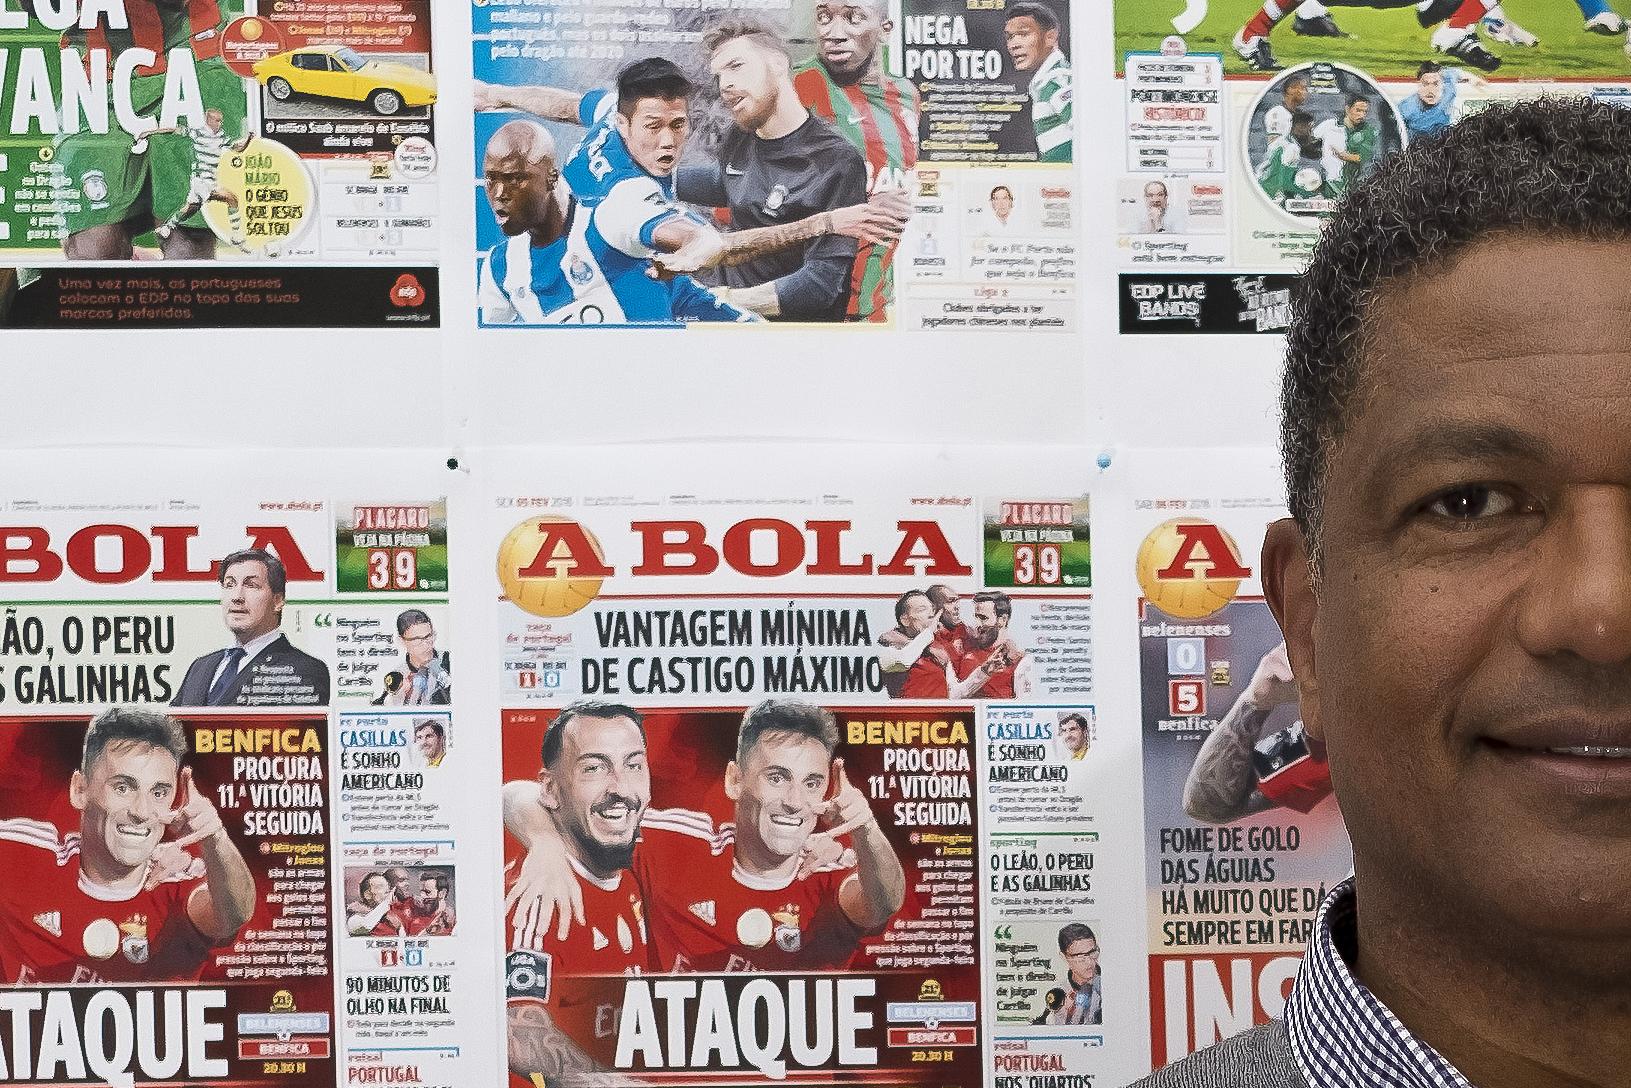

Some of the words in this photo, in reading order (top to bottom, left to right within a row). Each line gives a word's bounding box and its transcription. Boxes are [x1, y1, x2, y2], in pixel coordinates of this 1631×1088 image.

[905, 14, 967, 46] NEGA
[905, 50, 950, 79] POR
[958, 50, 1002, 80] TEO
[102, 279, 122, 290] vez
[0, 524, 324, 583] BOLA
[518, 521, 615, 578] A
[630, 518, 973, 577] BOLA
[1156, 524, 1252, 579] A
[63, 617, 83, 655] O
[93, 616, 175, 654] PERU
[594, 609, 754, 648] VANTAGEM
[761, 601, 872, 647] MÍNIMA
[581, 657, 618, 694] DE
[627, 656, 755, 693] CASTIGO
[762, 647, 884, 693] MÁXIMO
[15, 665, 172, 704] GALINHAS
[196, 729, 321, 753] BENFICA
[340, 730, 407, 747] CASILLAS
[847, 721, 968, 744] BENFICA
[987, 722, 1052, 740] CASILLAS
[353, 753, 401, 769] SONHO
[883, 749, 970, 772] PROCURA
[999, 745, 1045, 761] SONHO
[233, 757, 323, 781] PROCURA
[988, 766, 1069, 782] AMERICANO
[249, 778, 323, 808] VITÓRIA
[342, 774, 423, 790] AMERICANO
[899, 771, 971, 799] VITÓRIA
[244, 813, 323, 836] SEGUIDA
[893, 803, 972, 826] SEGUIDA
[1160, 827, 1213, 853] FOME
[1218, 828, 1242, 853] DE
[1247, 827, 1300, 852] GOLO
[1161, 859, 1198, 884] DAS
[1204, 852, 1275, 882] ÁGUIAS
[1022, 876, 1092, 893] GALINHAS
[1161, 884, 1187, 915] HÁ
[1193, 889, 1253, 914] MUITO
[1258, 887, 1298, 916] QUE
[1163, 919, 1241, 946] SEMPRE
[1246, 919, 1272, 944] EM
[347, 999, 384, 1015] OLHO
[411, 997, 450, 1014] FINAL
[614, 978, 878, 1080] ATAQUE
[348, 1066, 422, 1084] PORTUGAL
[994, 1054, 1066, 1072] PORTUGAL
